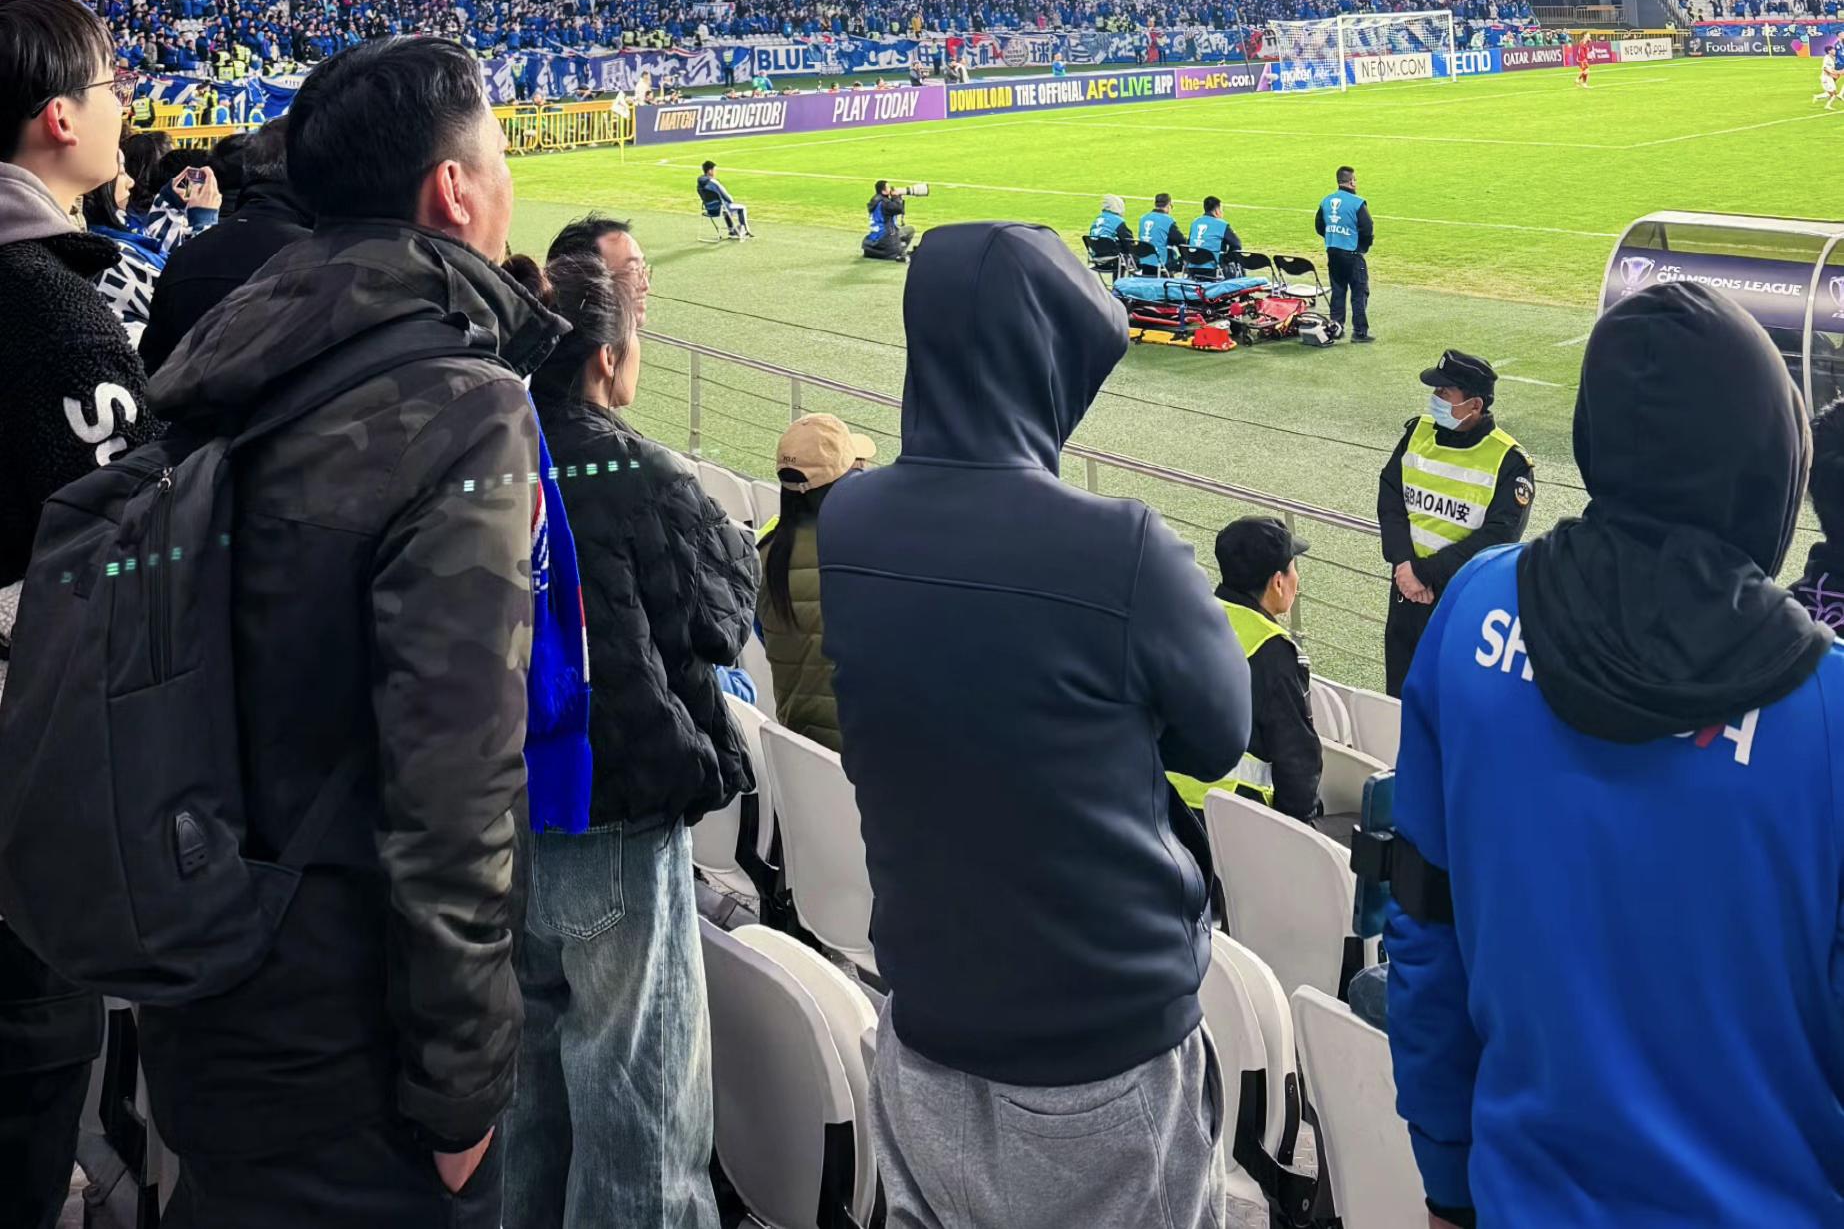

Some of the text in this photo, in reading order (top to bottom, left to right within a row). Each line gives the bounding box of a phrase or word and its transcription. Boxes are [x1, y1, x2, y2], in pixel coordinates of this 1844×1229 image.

[1705, 40, 1786, 53] Football Cares
[1443, 50, 1491, 74] TECNO
[1503, 47, 1563, 66] QATAR AIRWAYS
[1361, 58, 1427, 78] NEOM.COM
[1180, 73, 1255, 92] the-AFC.com
[950, 75, 1173, 112] DOWNLOAD THE OFFICIAL AFC LIVE APP
[833, 91, 920, 123] PLAY TODAY
[659, 102, 784, 132] MATCH PREDICTOR
[1659, 265, 1681, 273] AFC
[1744, 280, 1803, 296] LEAGUE
